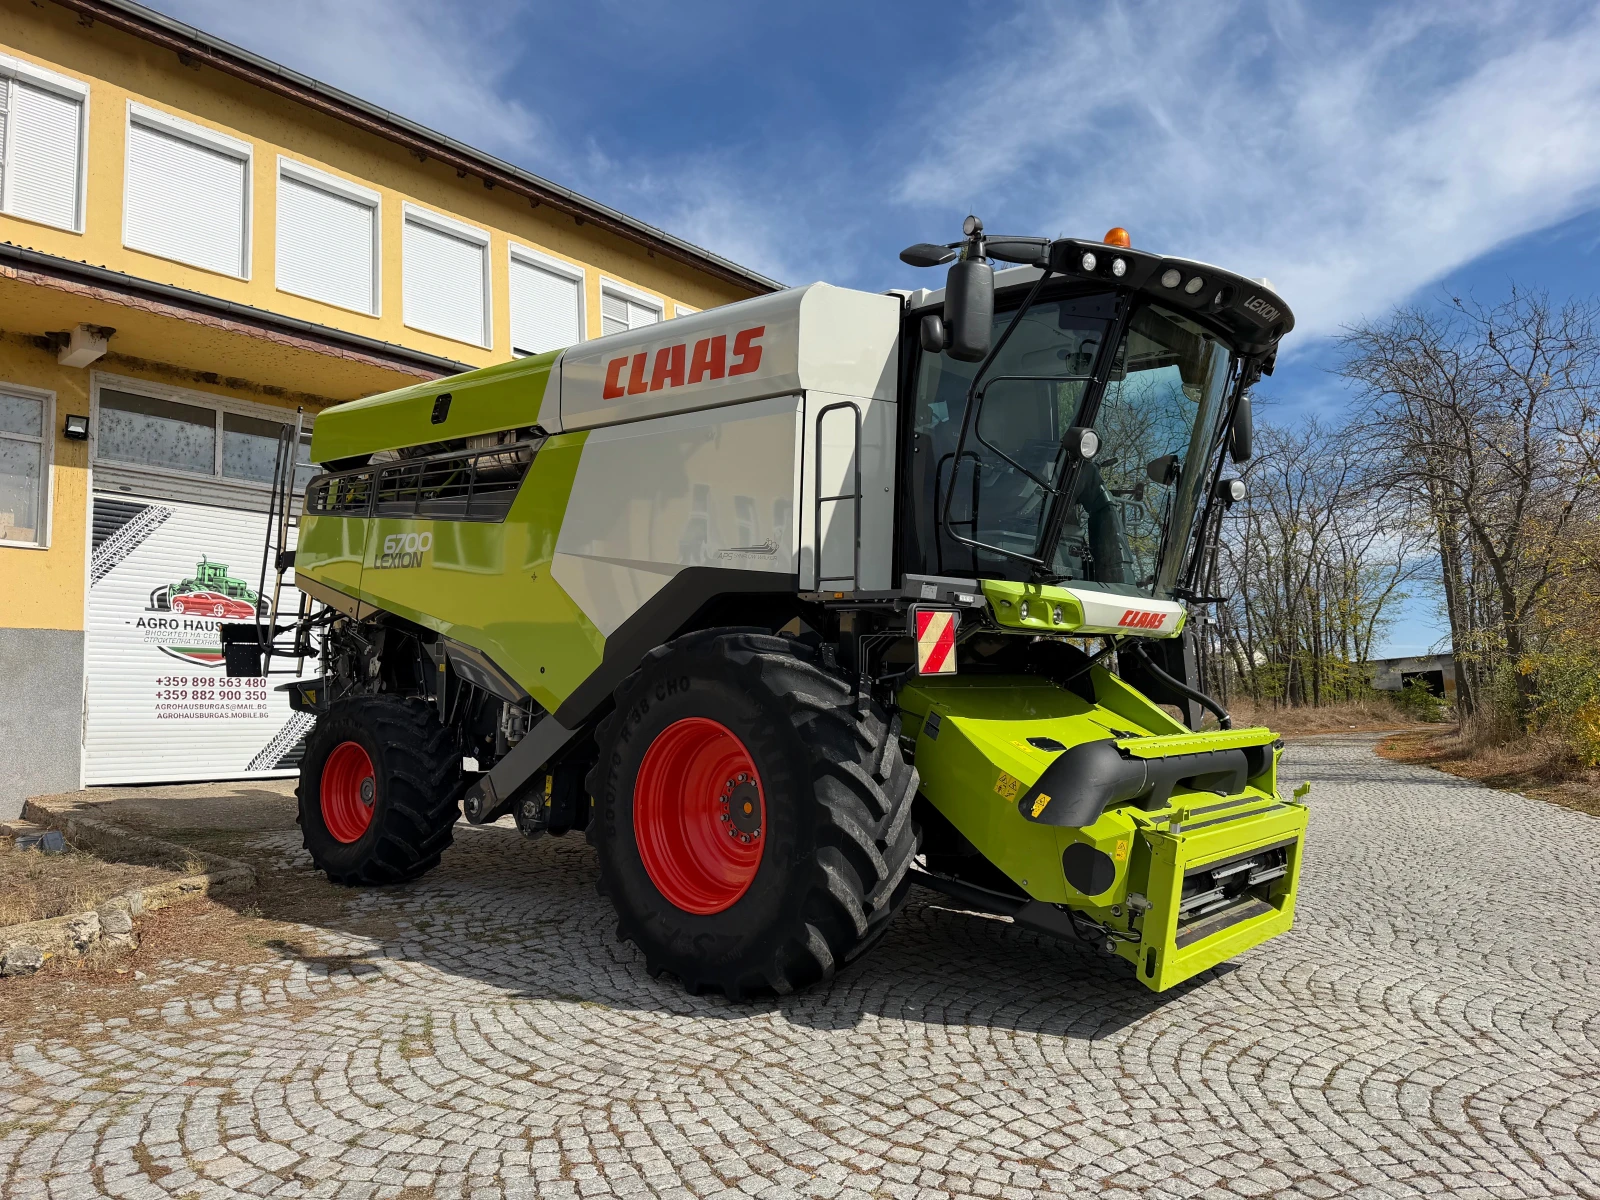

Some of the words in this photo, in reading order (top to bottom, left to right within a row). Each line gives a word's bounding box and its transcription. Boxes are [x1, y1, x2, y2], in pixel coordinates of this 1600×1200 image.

[1244, 296, 1280, 322] LEXION
[603, 325, 765, 400] CLAAS
[383, 532, 432, 554] 6700
[373, 552, 423, 569] LEXION
[136, 617, 179, 630] AGRO
[183, 619, 222, 632] HAUS
[1118, 609, 1167, 629] CLAAS
[155, 676, 188, 687] +359
[191, 677, 215, 687] 898
[219, 677, 241, 688] 563
[245, 678, 267, 688] 480
[155, 690, 188, 700] +359
[191, 690, 215, 700] 882
[219, 690, 242, 701] 900
[245, 691, 267, 701] 350
[631, 698, 650, 724] 38
